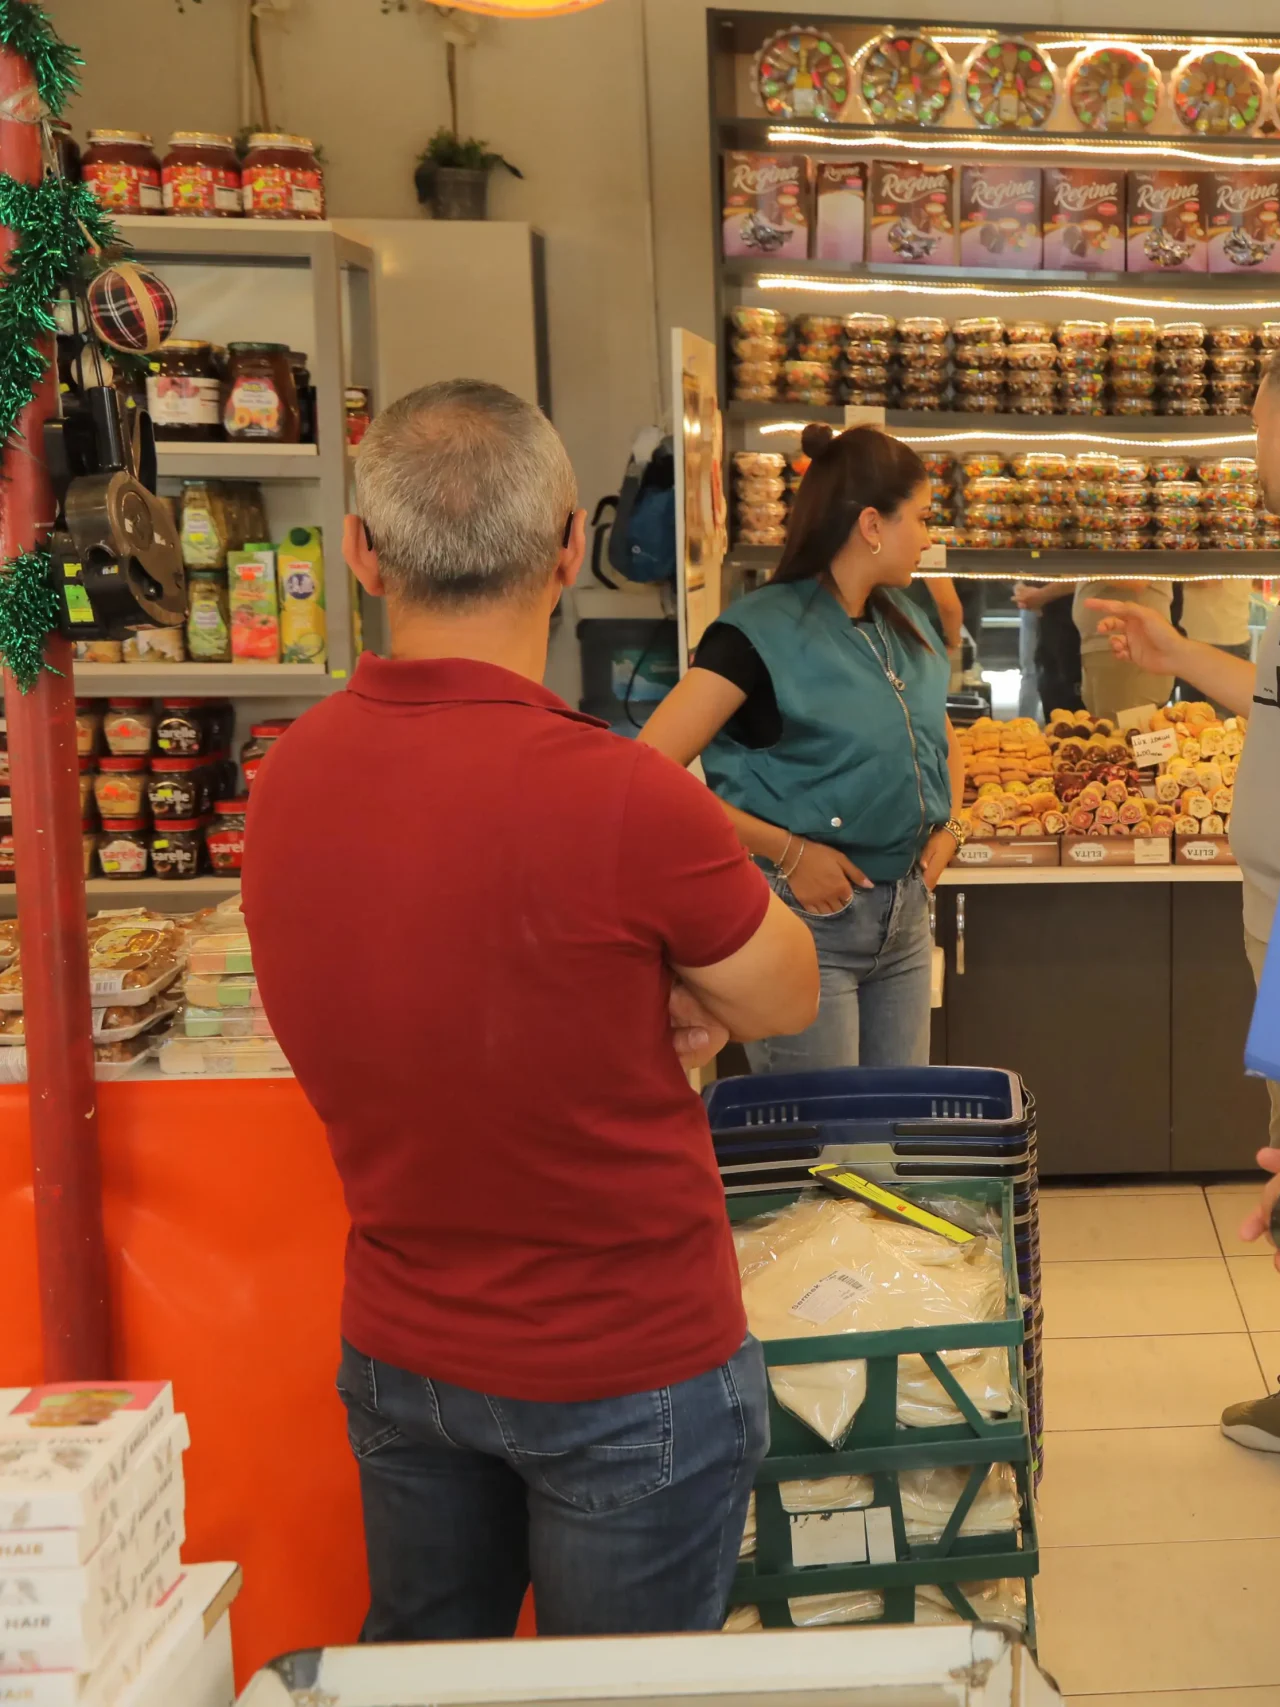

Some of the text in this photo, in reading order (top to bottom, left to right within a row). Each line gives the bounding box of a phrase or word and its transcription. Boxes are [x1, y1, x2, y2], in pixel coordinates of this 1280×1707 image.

[733, 164, 799, 194] Regina
[881, 172, 946, 203] Regina
[970, 179, 1035, 209] Regina
[1054, 182, 1118, 212] Regina
[1137, 182, 1200, 213] Regina
[1216, 181, 1279, 213] Regina
[210, 840, 245, 853] sarel
